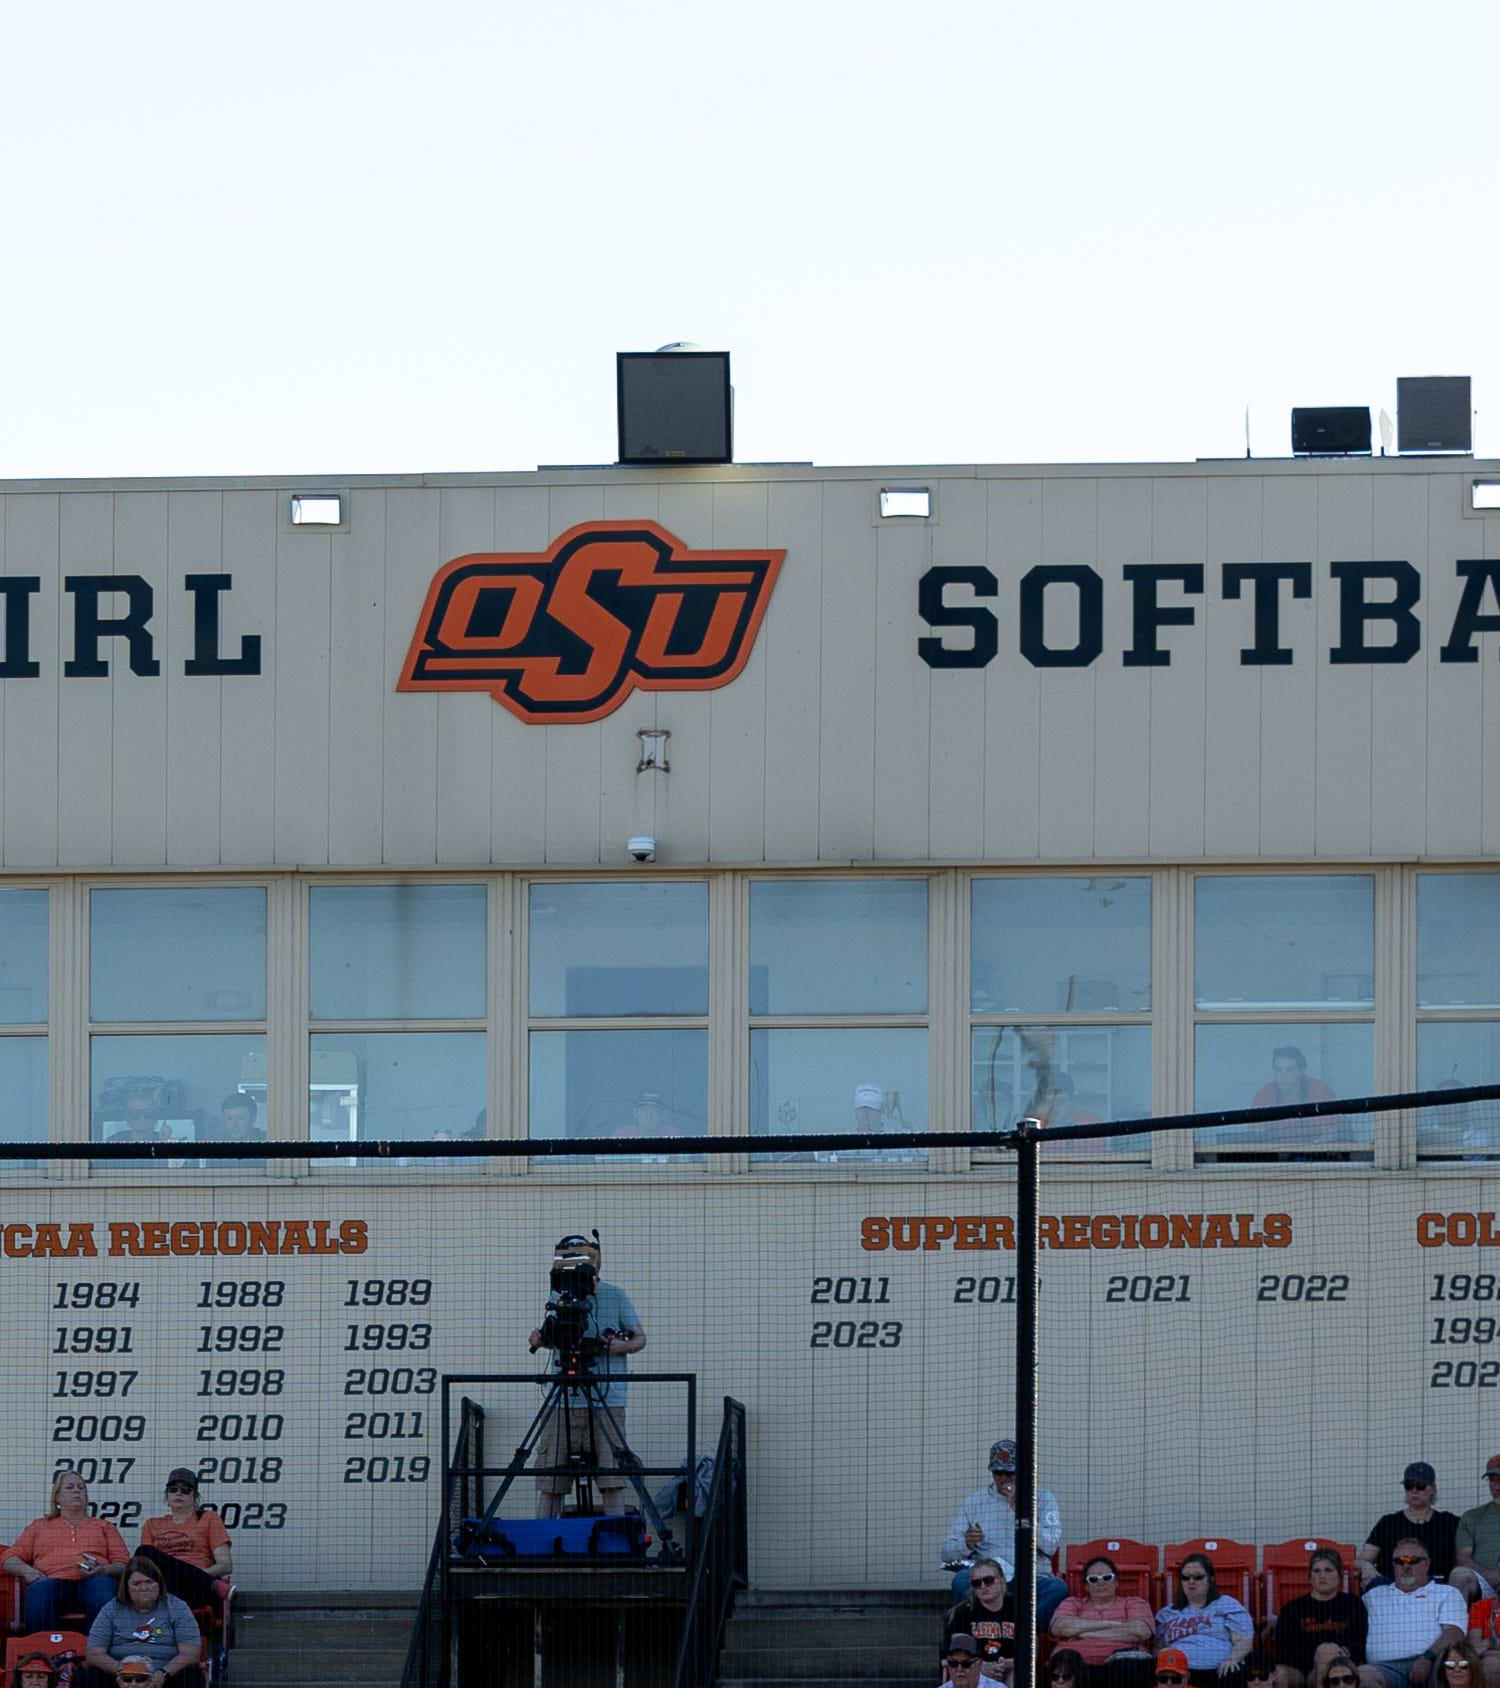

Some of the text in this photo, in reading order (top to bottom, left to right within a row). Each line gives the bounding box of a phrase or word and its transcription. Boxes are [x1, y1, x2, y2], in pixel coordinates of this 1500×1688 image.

[398, 521, 787, 723] OSU
[109, 1221, 366, 1256] REGIONALS
[862, 1216, 1291, 1250] SUPER REGIONALS
[54, 1283, 139, 1308] 1984
[198, 1281, 285, 1307] 1988
[345, 1280, 432, 1306] 1989
[811, 1275, 1349, 1303] 2011 201 2021 2022
[54, 1327, 132, 1353] 1991
[198, 1326, 284, 1352] 1992
[345, 1324, 431, 1350] 1993
[811, 1322, 902, 1348] 2023
[53, 1371, 138, 1397] 1997
[197, 1370, 284, 1396] 1998
[345, 1368, 436, 1394] 2003
[53, 1416, 145, 1441] 2009
[197, 1415, 283, 1441] 2010
[345, 1412, 423, 1438] 2011
[53, 1458, 136, 1483] 2017
[198, 1457, 283, 1484] 2018
[344, 1453, 436, 1481] 2019
[87, 1502, 142, 1528] 22
